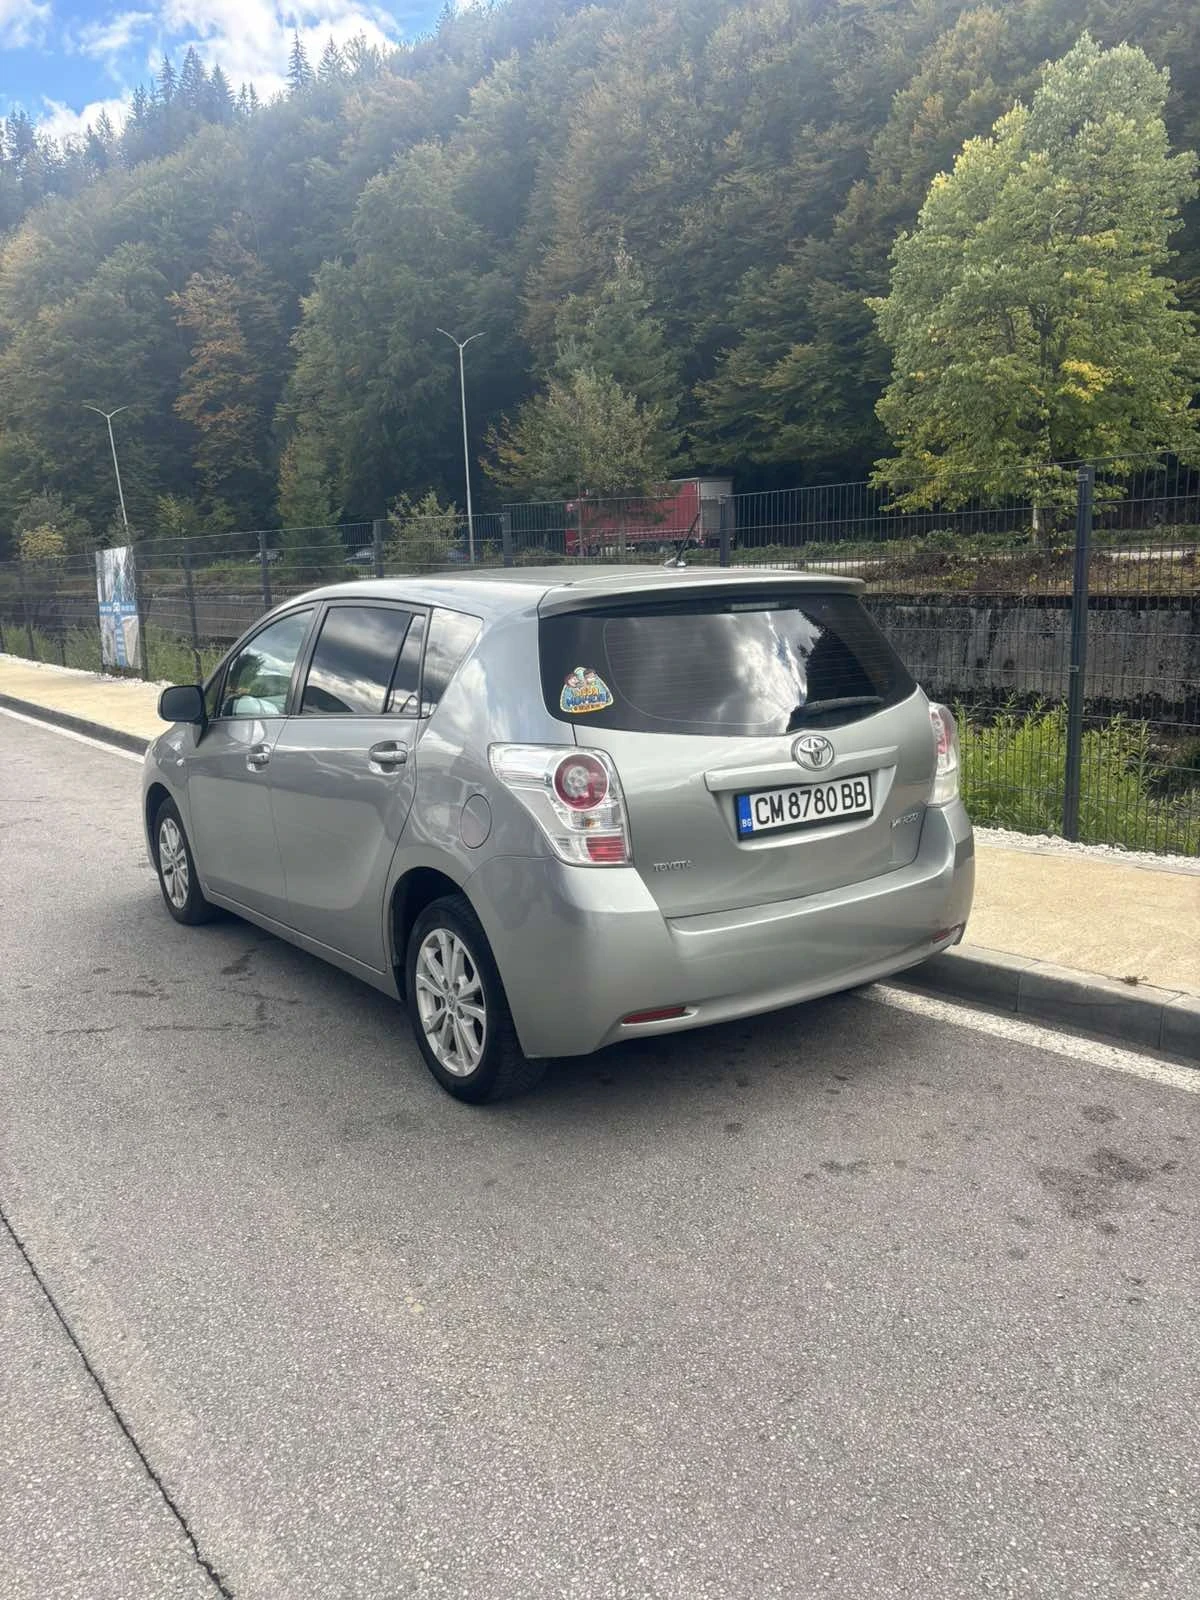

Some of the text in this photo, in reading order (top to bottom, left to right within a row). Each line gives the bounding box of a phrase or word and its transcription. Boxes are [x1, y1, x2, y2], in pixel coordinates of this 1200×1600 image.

[755, 782, 867, 824] CM 8780 BB
[742, 818, 752, 828] BG
